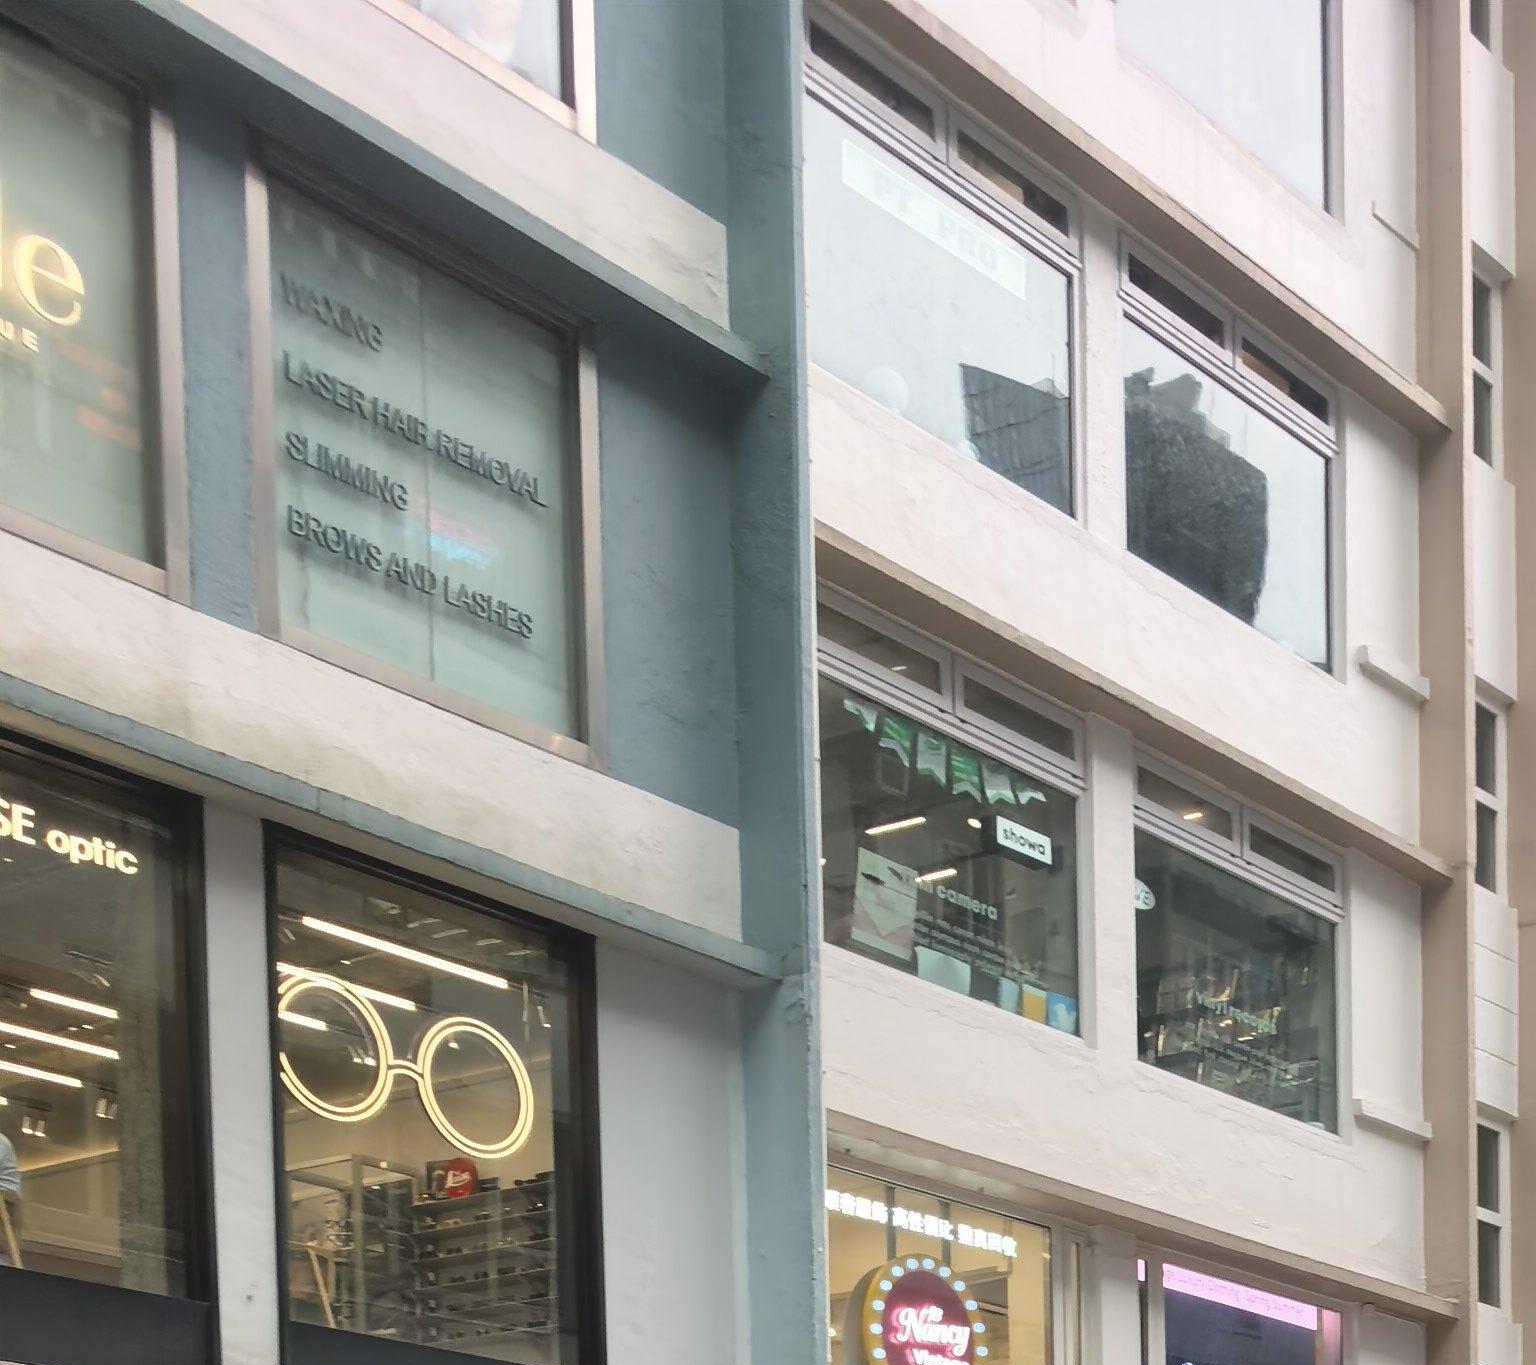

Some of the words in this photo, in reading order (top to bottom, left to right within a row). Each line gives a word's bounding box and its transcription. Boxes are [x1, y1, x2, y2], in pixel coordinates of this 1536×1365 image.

[281, 272, 383, 351] WAXING
[282, 350, 368, 420] LASER
[371, 396, 431, 448] HAIR
[435, 428, 549, 508] REMOVAL
[285, 430, 408, 511] SLIMMING
[286, 504, 382, 572] BROWS
[385, 551, 436, 595] AND
[443, 575, 533, 640] LASHES
[46, 829, 138, 875] optic
[1002, 827, 1046, 856] showa
[936, 885, 998, 920] camera
[896, 1307, 970, 1357] Nancy
